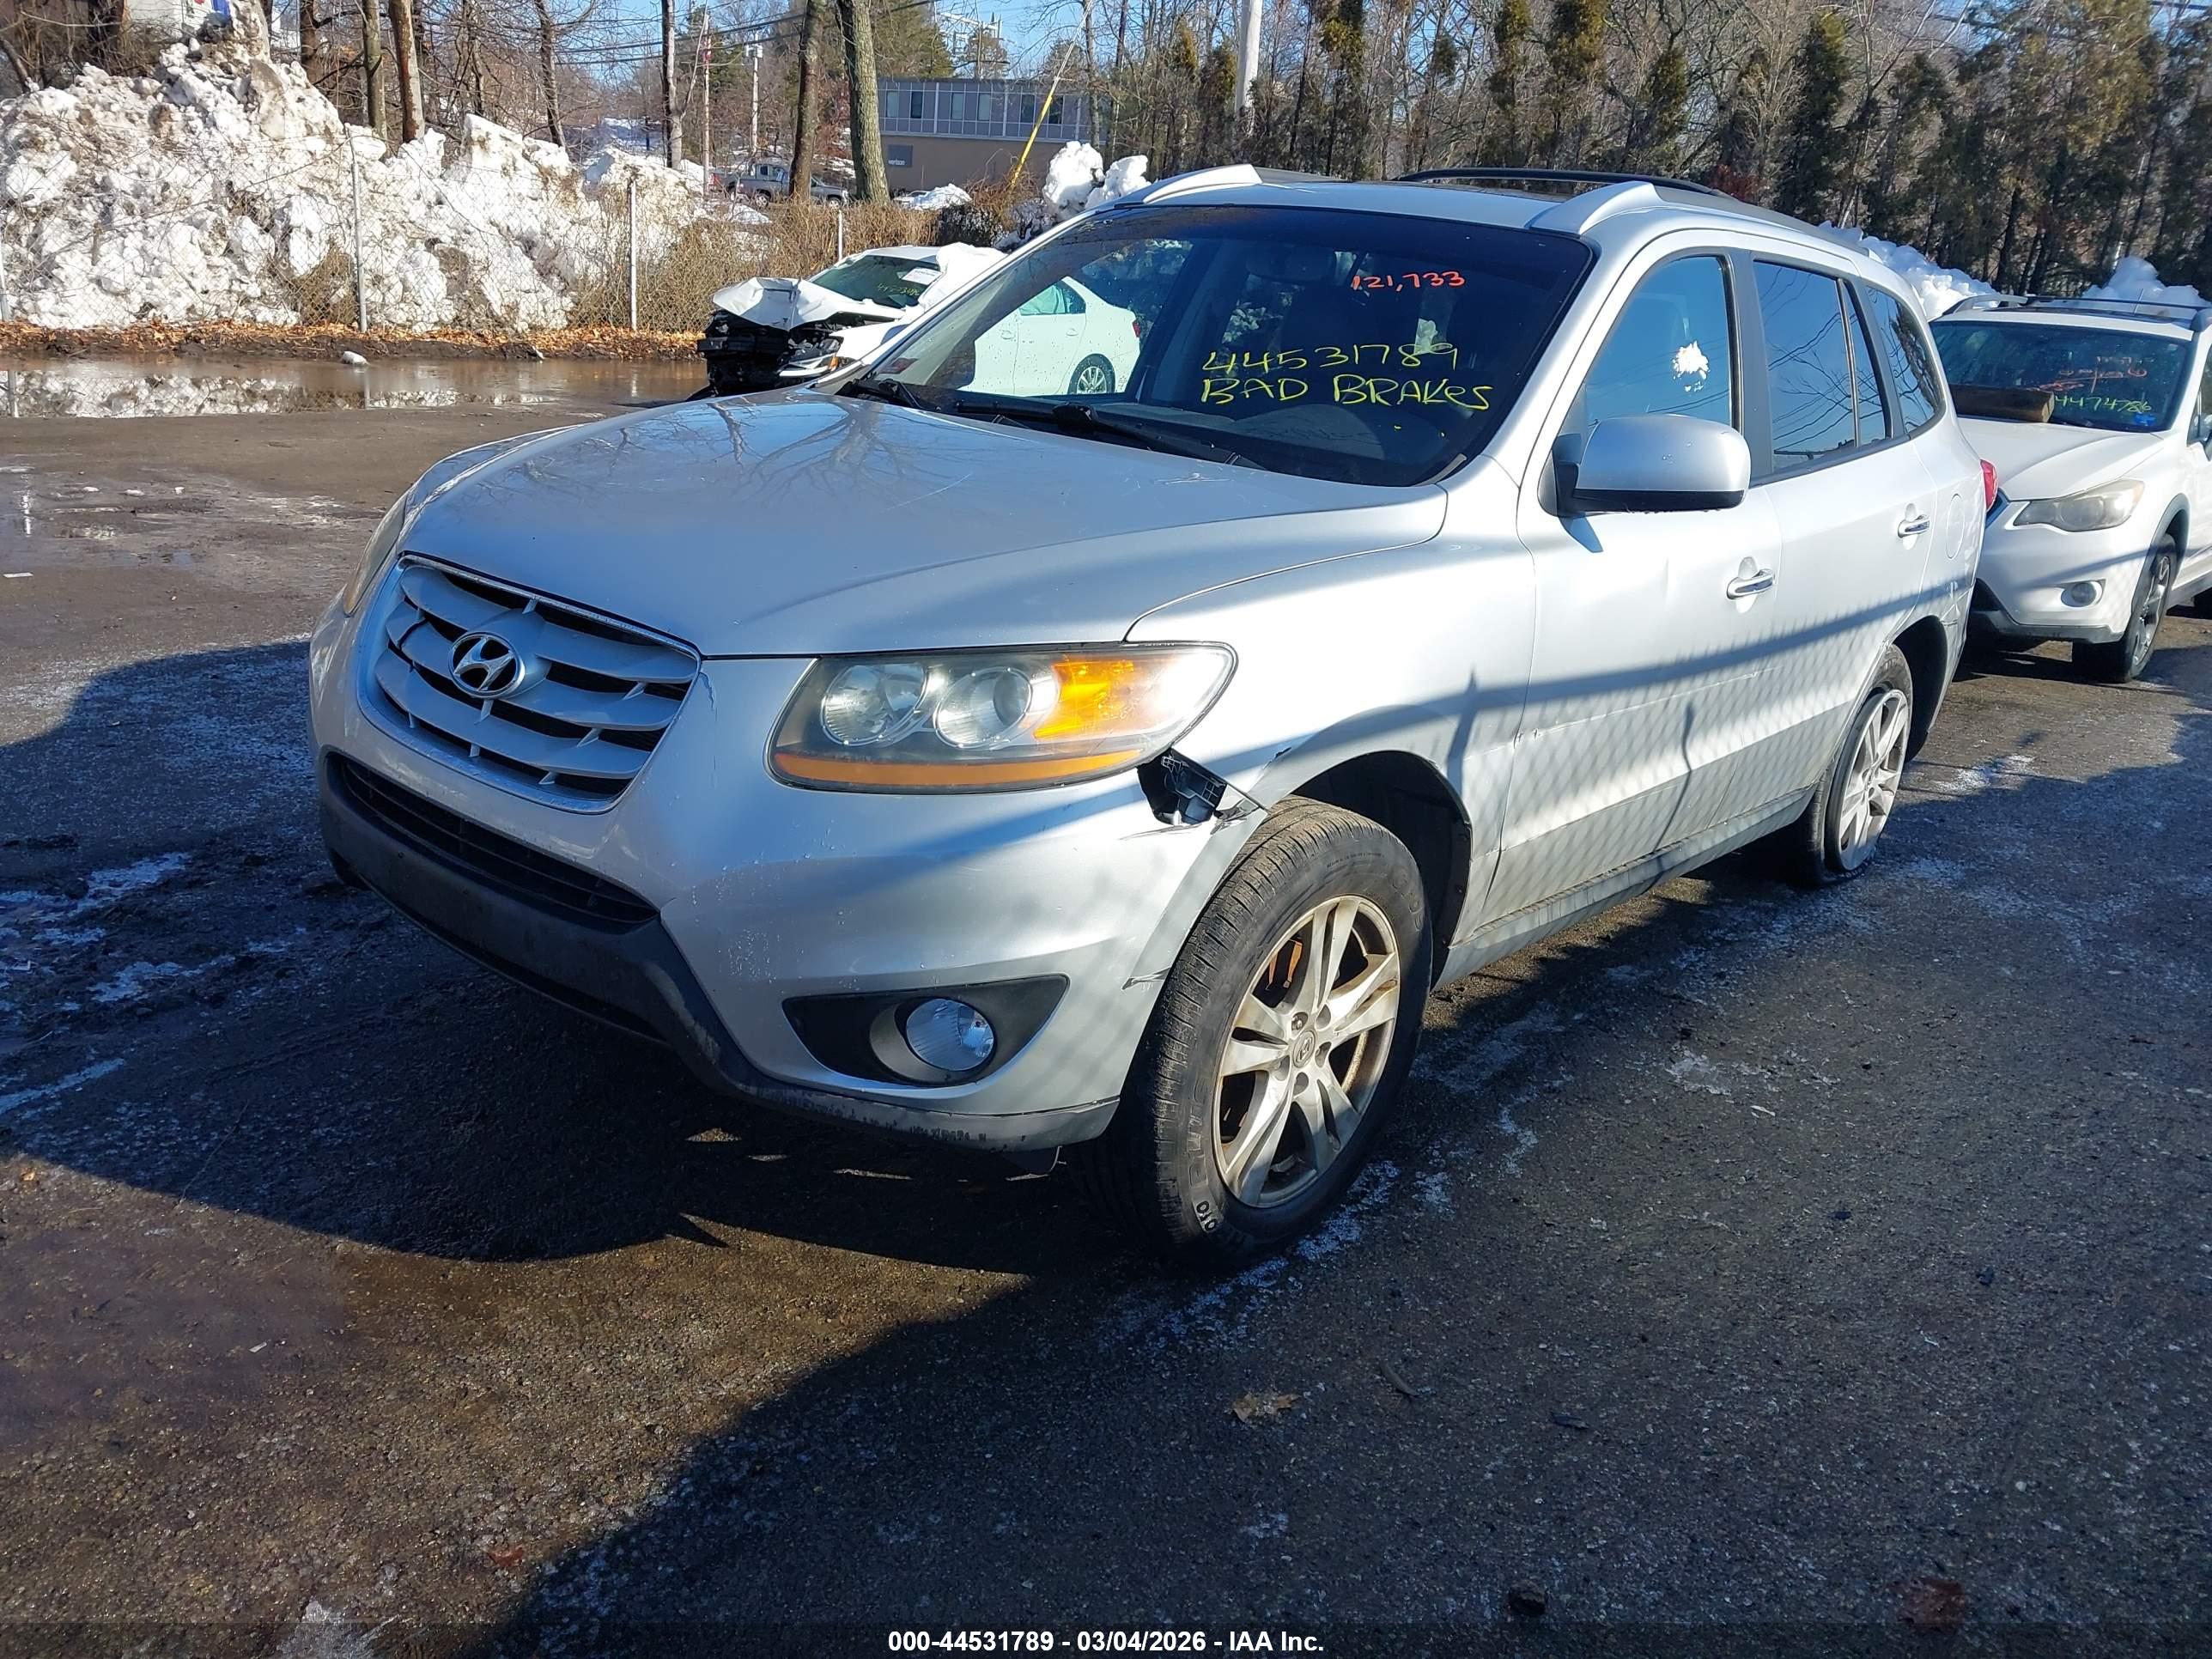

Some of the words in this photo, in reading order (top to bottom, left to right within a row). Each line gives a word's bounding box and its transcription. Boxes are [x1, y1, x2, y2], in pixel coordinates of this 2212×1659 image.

[1352, 270, 1465, 291] 121,733
[1203, 343, 1458, 373] 44531789
[1202, 378, 1308, 404] BAD
